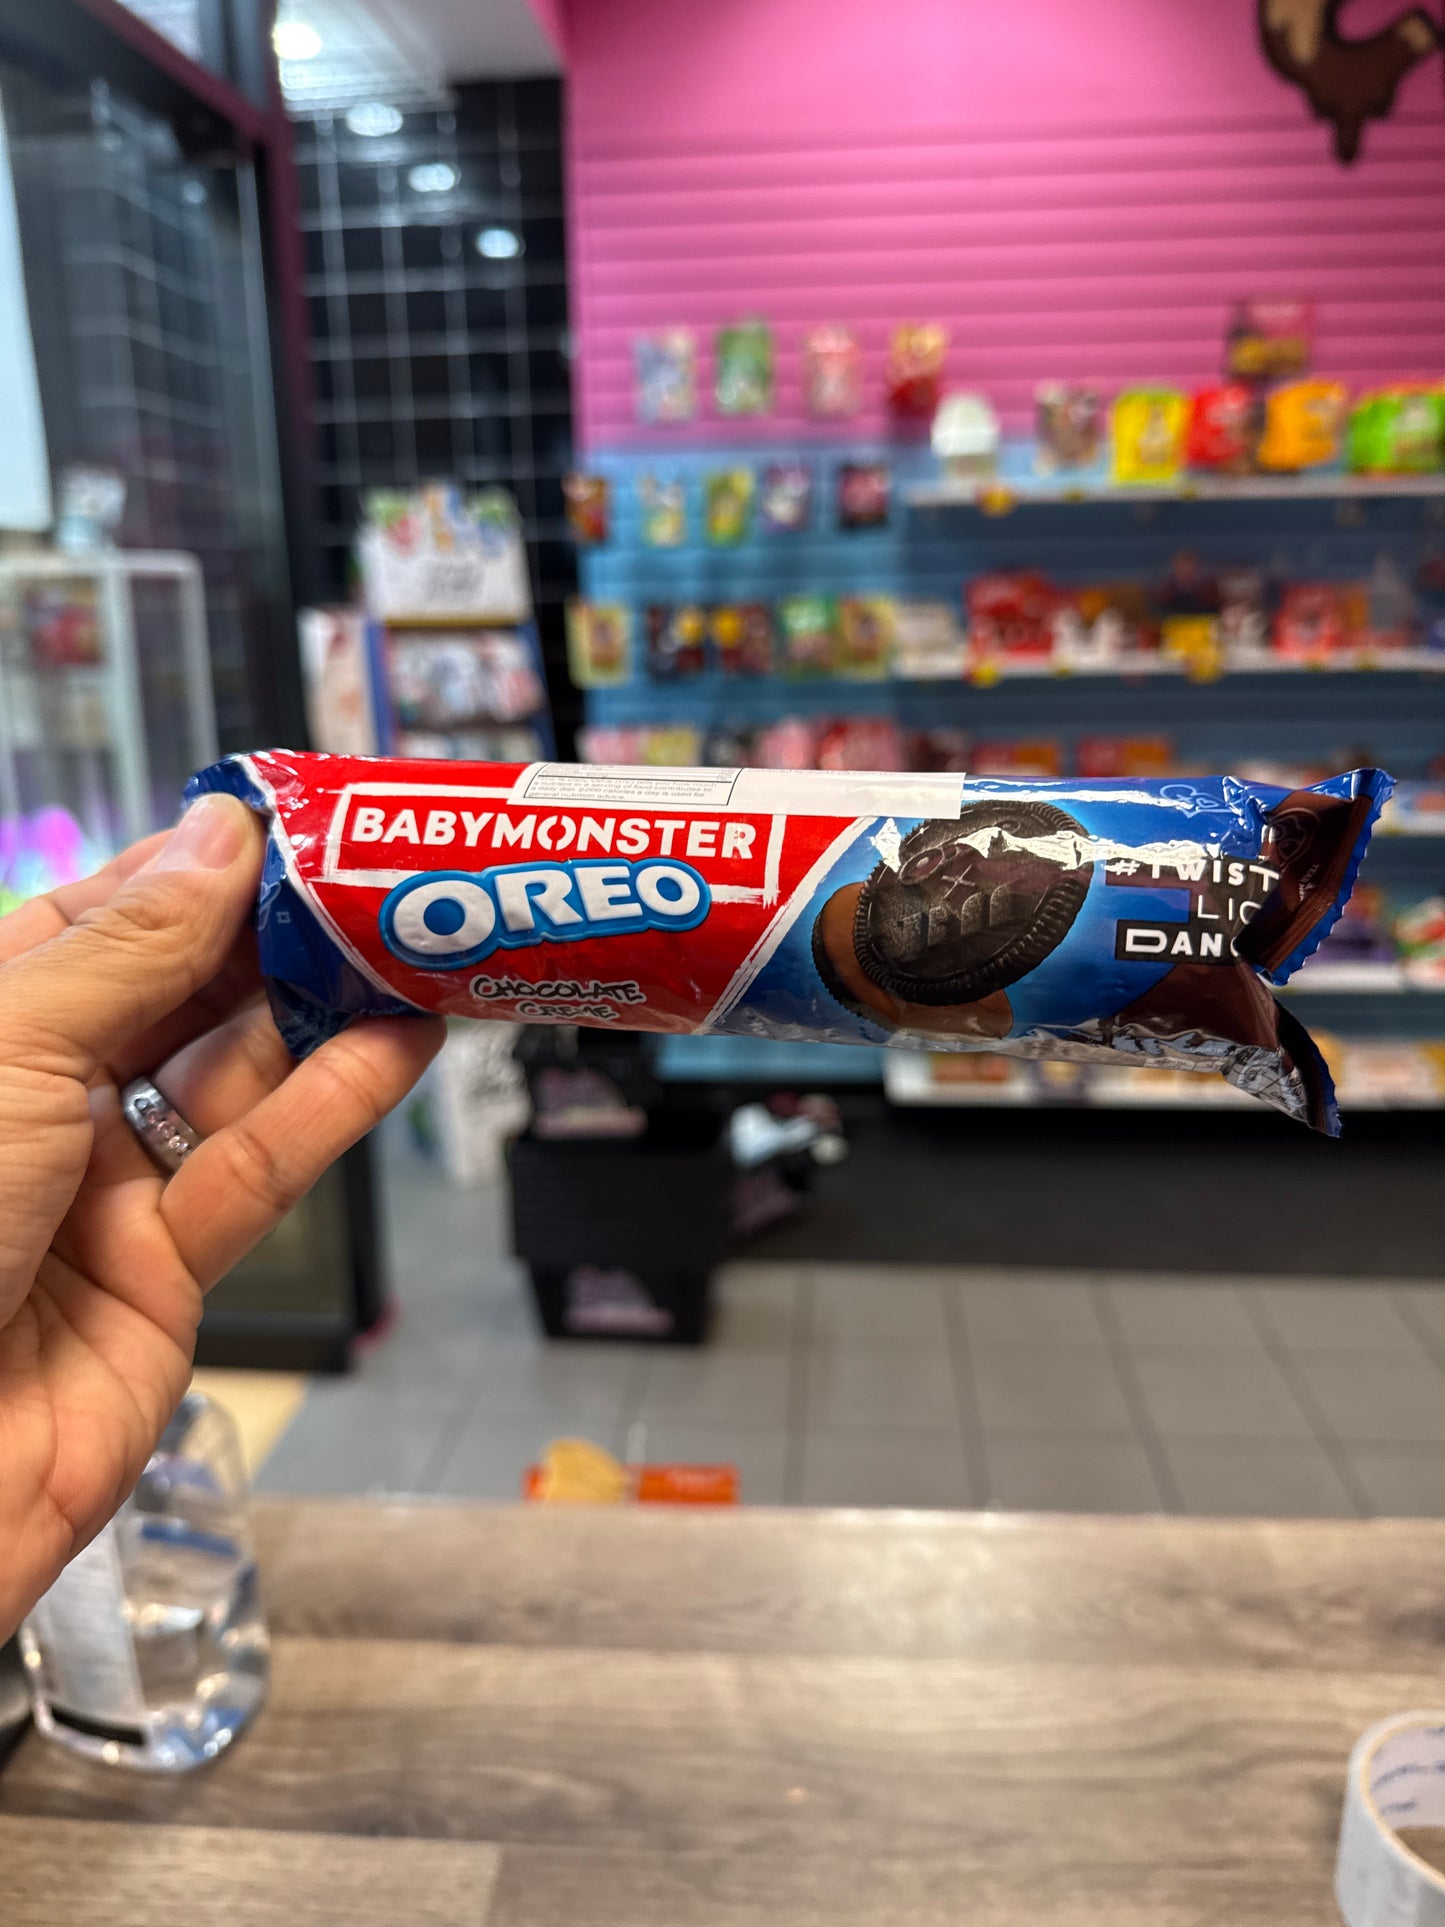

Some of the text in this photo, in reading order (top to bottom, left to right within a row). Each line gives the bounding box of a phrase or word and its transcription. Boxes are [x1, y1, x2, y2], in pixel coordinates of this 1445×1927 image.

[351, 807, 757, 860] BABYMONSTER
[393, 865, 701, 956] OREO
[1125, 928, 1239, 958] DAN
[472, 976, 645, 1002] CHOCOLATE
[518, 1001, 618, 1019] CREME
